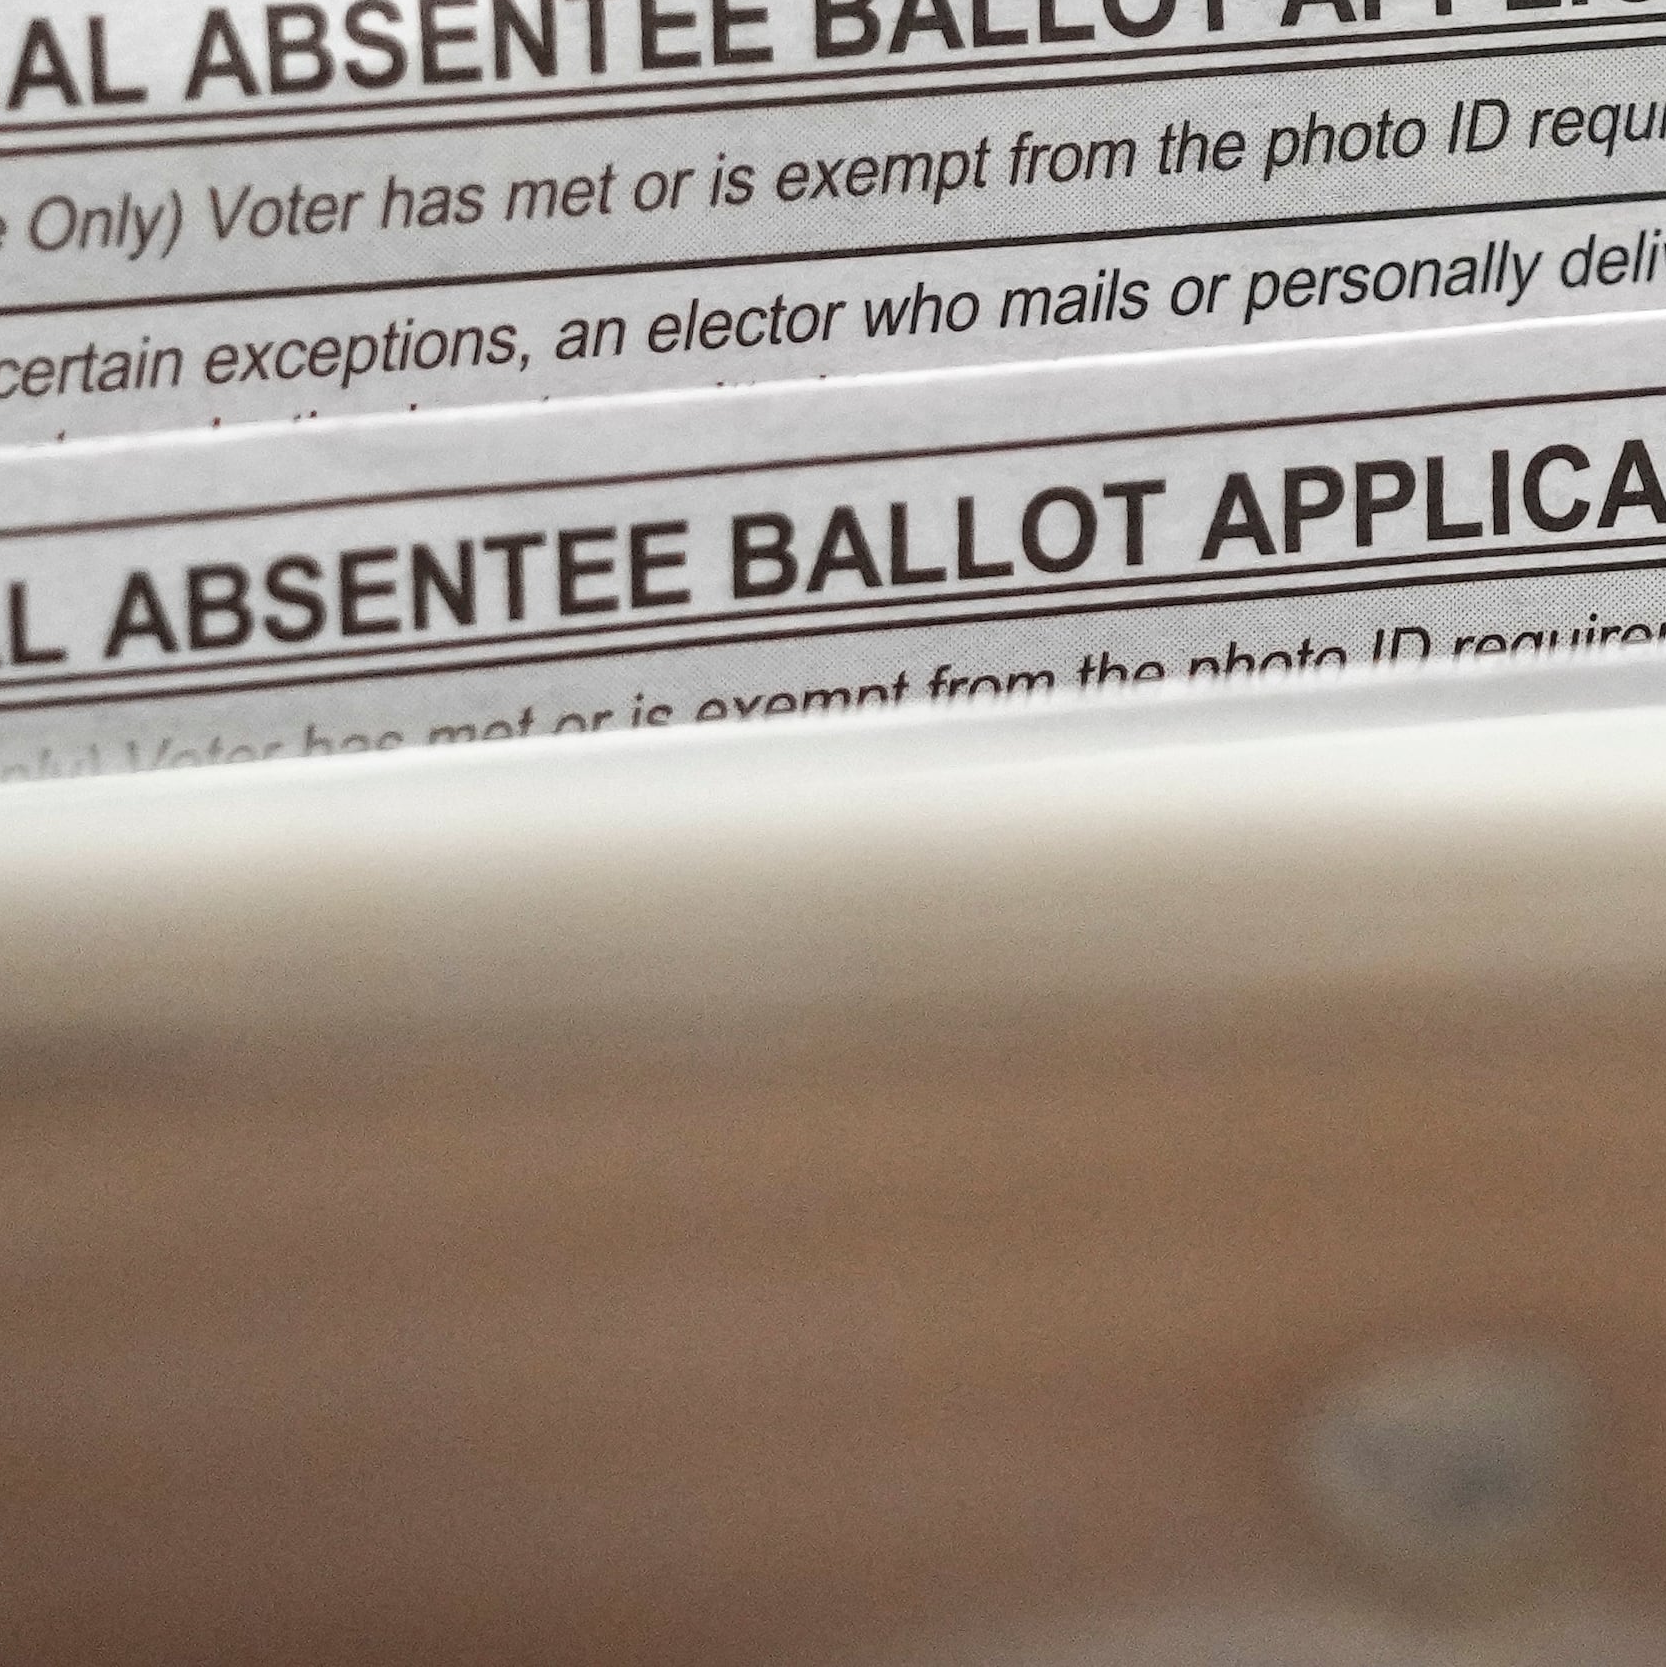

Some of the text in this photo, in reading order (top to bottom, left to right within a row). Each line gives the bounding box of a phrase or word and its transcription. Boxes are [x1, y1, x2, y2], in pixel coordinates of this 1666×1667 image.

[30, 190, 181, 262] Only)
[209, 182, 364, 240] Voter
[381, 175, 484, 230] has
[506, 165, 614, 222] met
[634, 163, 695, 209] or
[710, 153, 754, 206] is
[776, 137, 990, 213] exempt
[1009, 131, 1135, 187] from
[1158, 120, 1244, 177] the
[1263, 105, 1425, 181] photo
[1449, 99, 1509, 154] ID
[203, 319, 531, 387] exceptions,
[555, 313, 624, 360] an
[648, 298, 844, 354] elector
[863, 282, 980, 338] who
[1000, 268, 1149, 327] mails
[1170, 272, 1230, 317] or
[1244, 240, 1540, 323] personally
[104, 519, 690, 657] ABSENTEE
[732, 480, 1166, 598] BALLOT
